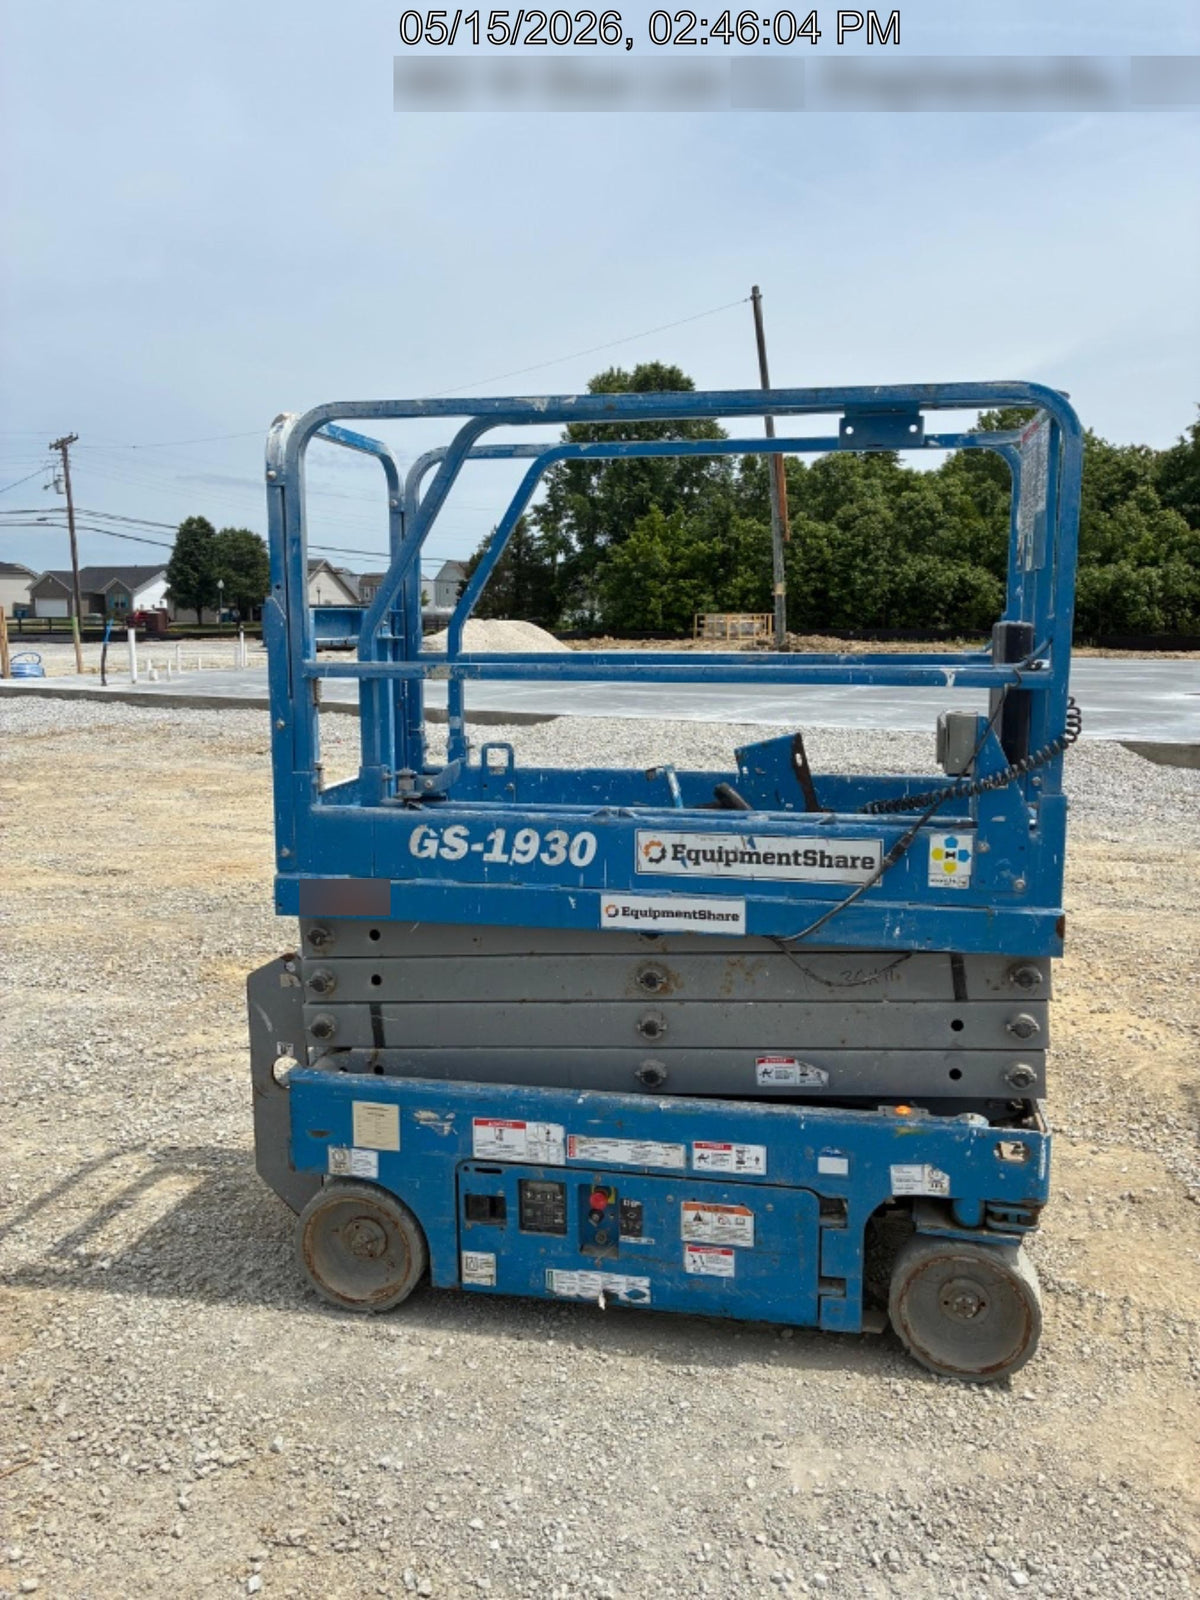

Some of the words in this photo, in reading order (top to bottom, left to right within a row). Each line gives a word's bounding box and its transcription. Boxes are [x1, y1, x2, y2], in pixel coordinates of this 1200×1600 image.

[408, 823, 598, 868] GS-1930
[671, 843, 875, 870] EquipmentShare
[620, 905, 741, 922] EquipmentShare
